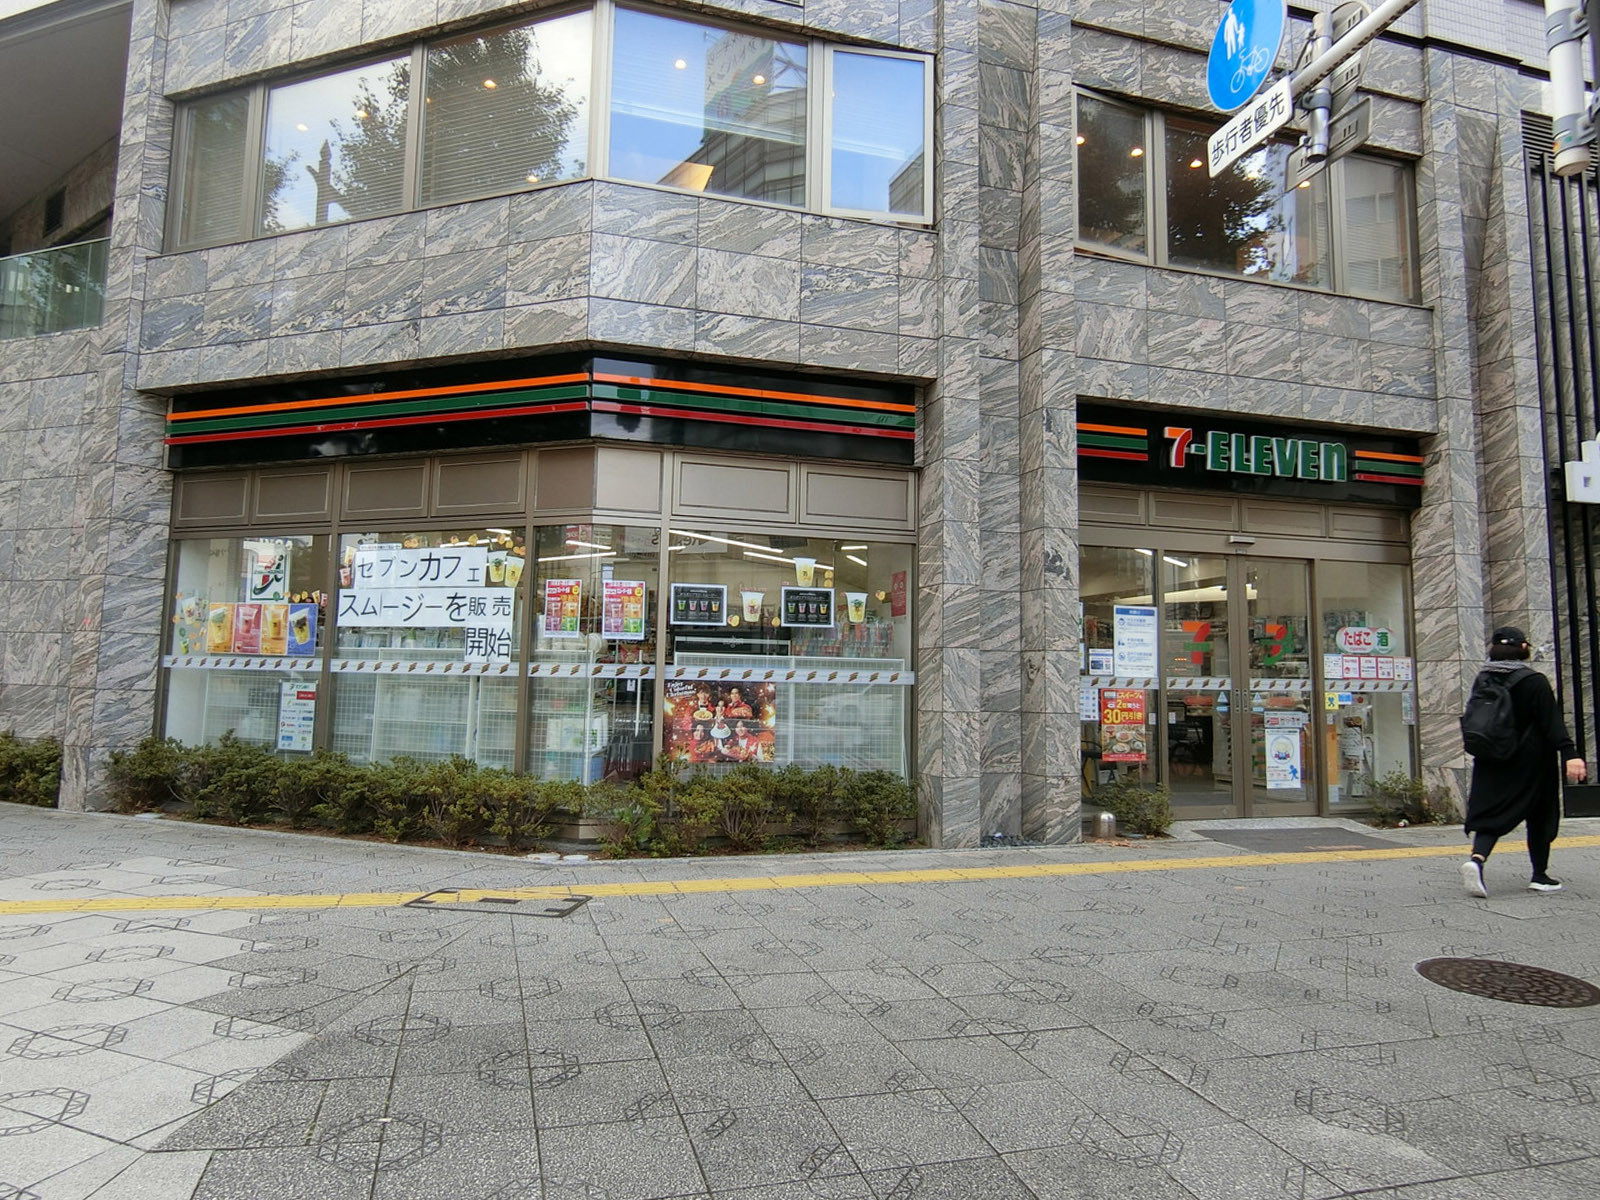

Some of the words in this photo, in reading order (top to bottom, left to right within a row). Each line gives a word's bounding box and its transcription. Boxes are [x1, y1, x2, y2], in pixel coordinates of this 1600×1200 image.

[1211, 92, 1285, 167] 歩行者優先
[357, 552, 481, 582] セブンカフェ
[339, 591, 512, 622] スムージーを販売
[465, 627, 512, 658] 開始
[1343, 631, 1371, 646] たばこ
[1376, 631, 1389, 647] 酒
